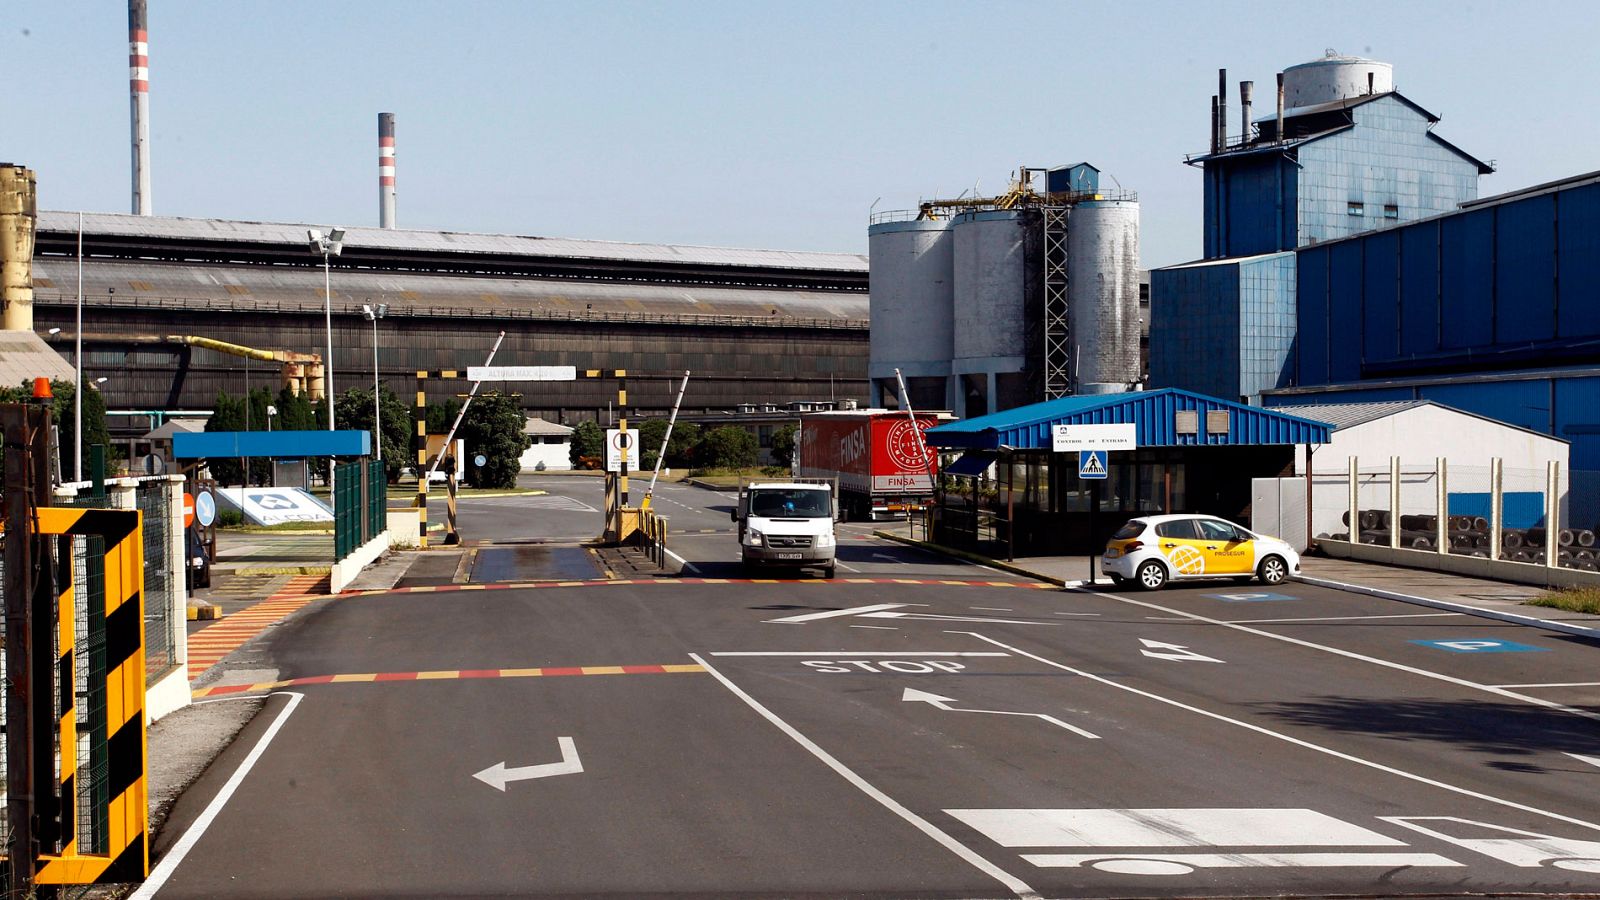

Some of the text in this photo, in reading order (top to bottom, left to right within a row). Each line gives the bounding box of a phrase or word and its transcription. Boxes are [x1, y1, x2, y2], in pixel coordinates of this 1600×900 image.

[840, 425, 866, 468] FINSA
[901, 439, 927, 448] FINA
[909, 430, 919, 457] FINSA
[888, 478, 916, 486] FINSA
[263, 513, 334, 521] ALCOA
[799, 660, 966, 674] STOP
